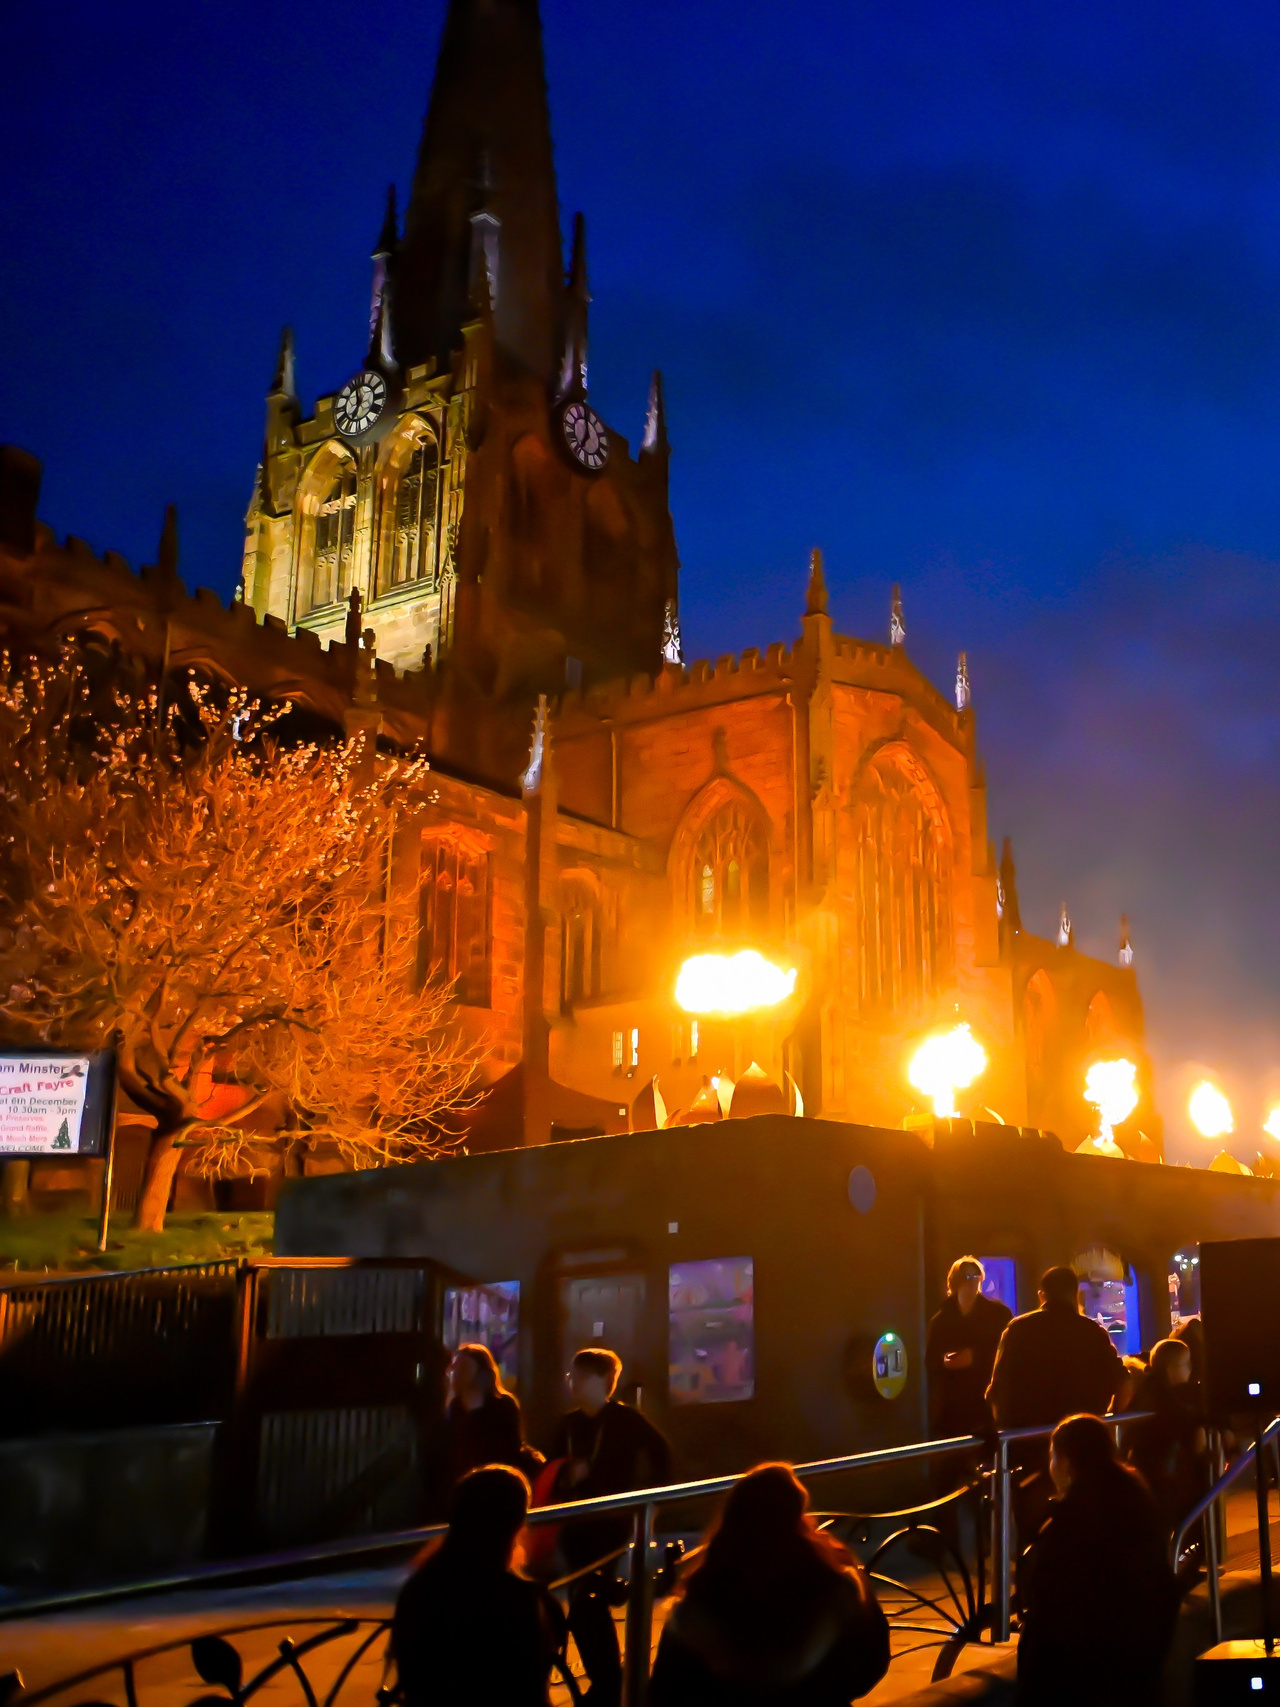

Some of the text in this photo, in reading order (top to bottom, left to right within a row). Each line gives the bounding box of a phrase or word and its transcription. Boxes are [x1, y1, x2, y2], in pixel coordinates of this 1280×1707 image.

[19, 1063, 65, 1074] Minster
[0, 1080, 74, 1095] Craft Fayre
[11, 1097, 26, 1105] 6th
[29, 1098, 78, 1106] December
[56, 1106, 77, 1116] 3pm
